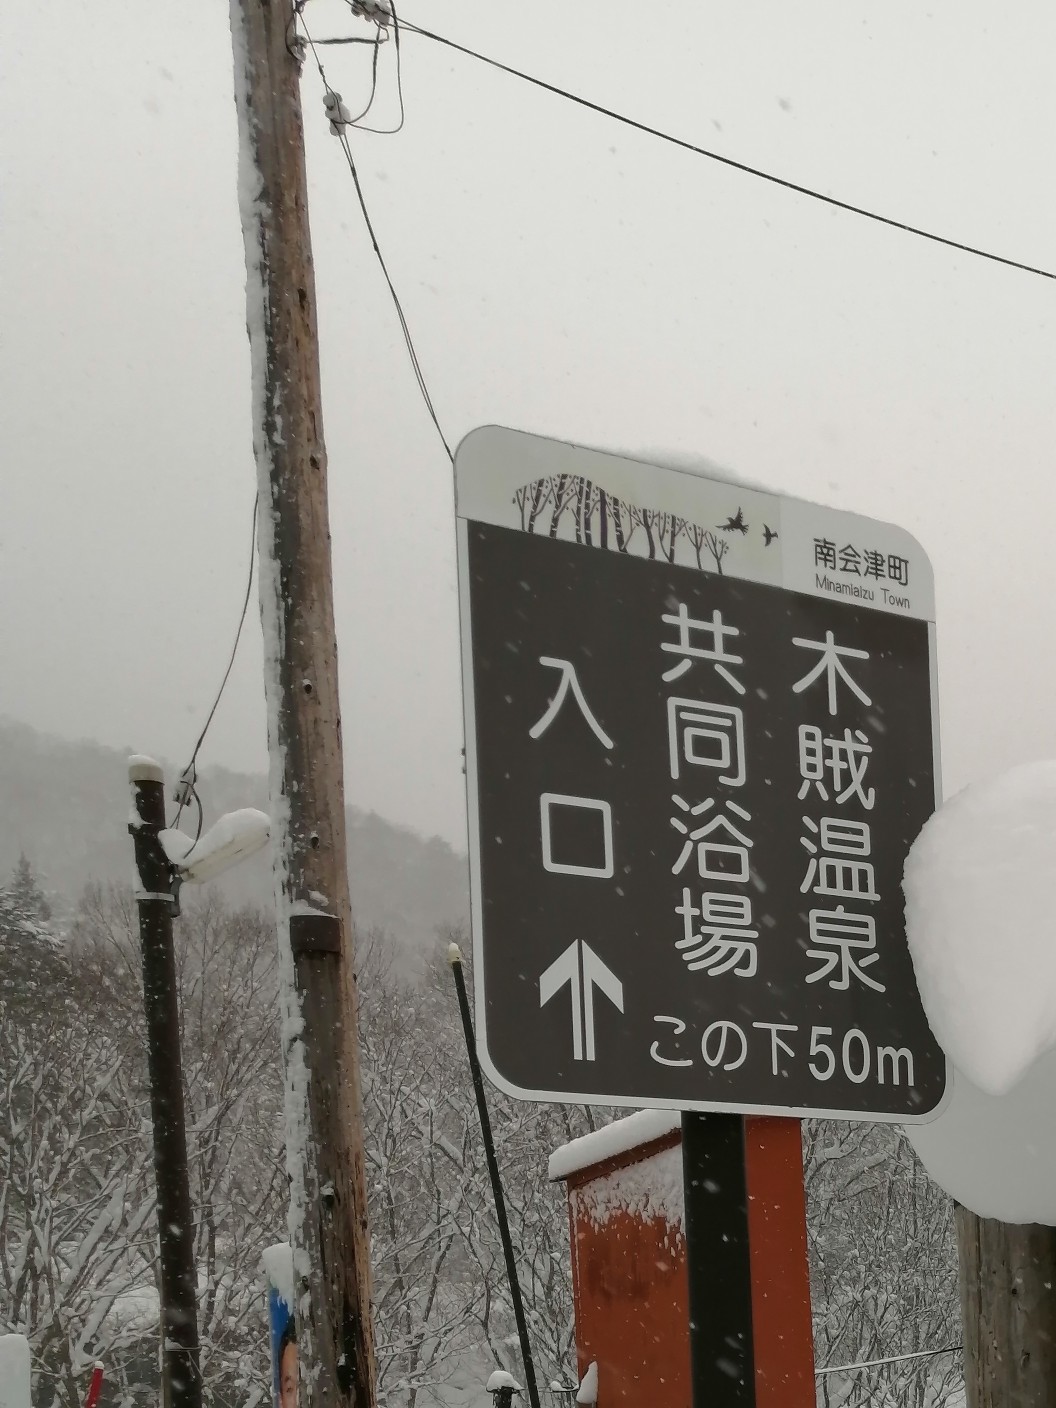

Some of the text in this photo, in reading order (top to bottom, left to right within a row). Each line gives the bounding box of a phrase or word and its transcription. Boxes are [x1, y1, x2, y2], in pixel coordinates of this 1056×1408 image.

[813, 538, 909, 586] 南会津町
[815, 573, 911, 609] Minamiaizu Town
[529, 656, 614, 879] 入口
[661, 603, 758, 978] 共同浴場
[792, 630, 886, 993] 木賊温泉
[648, 1015, 914, 1087] この下50m
